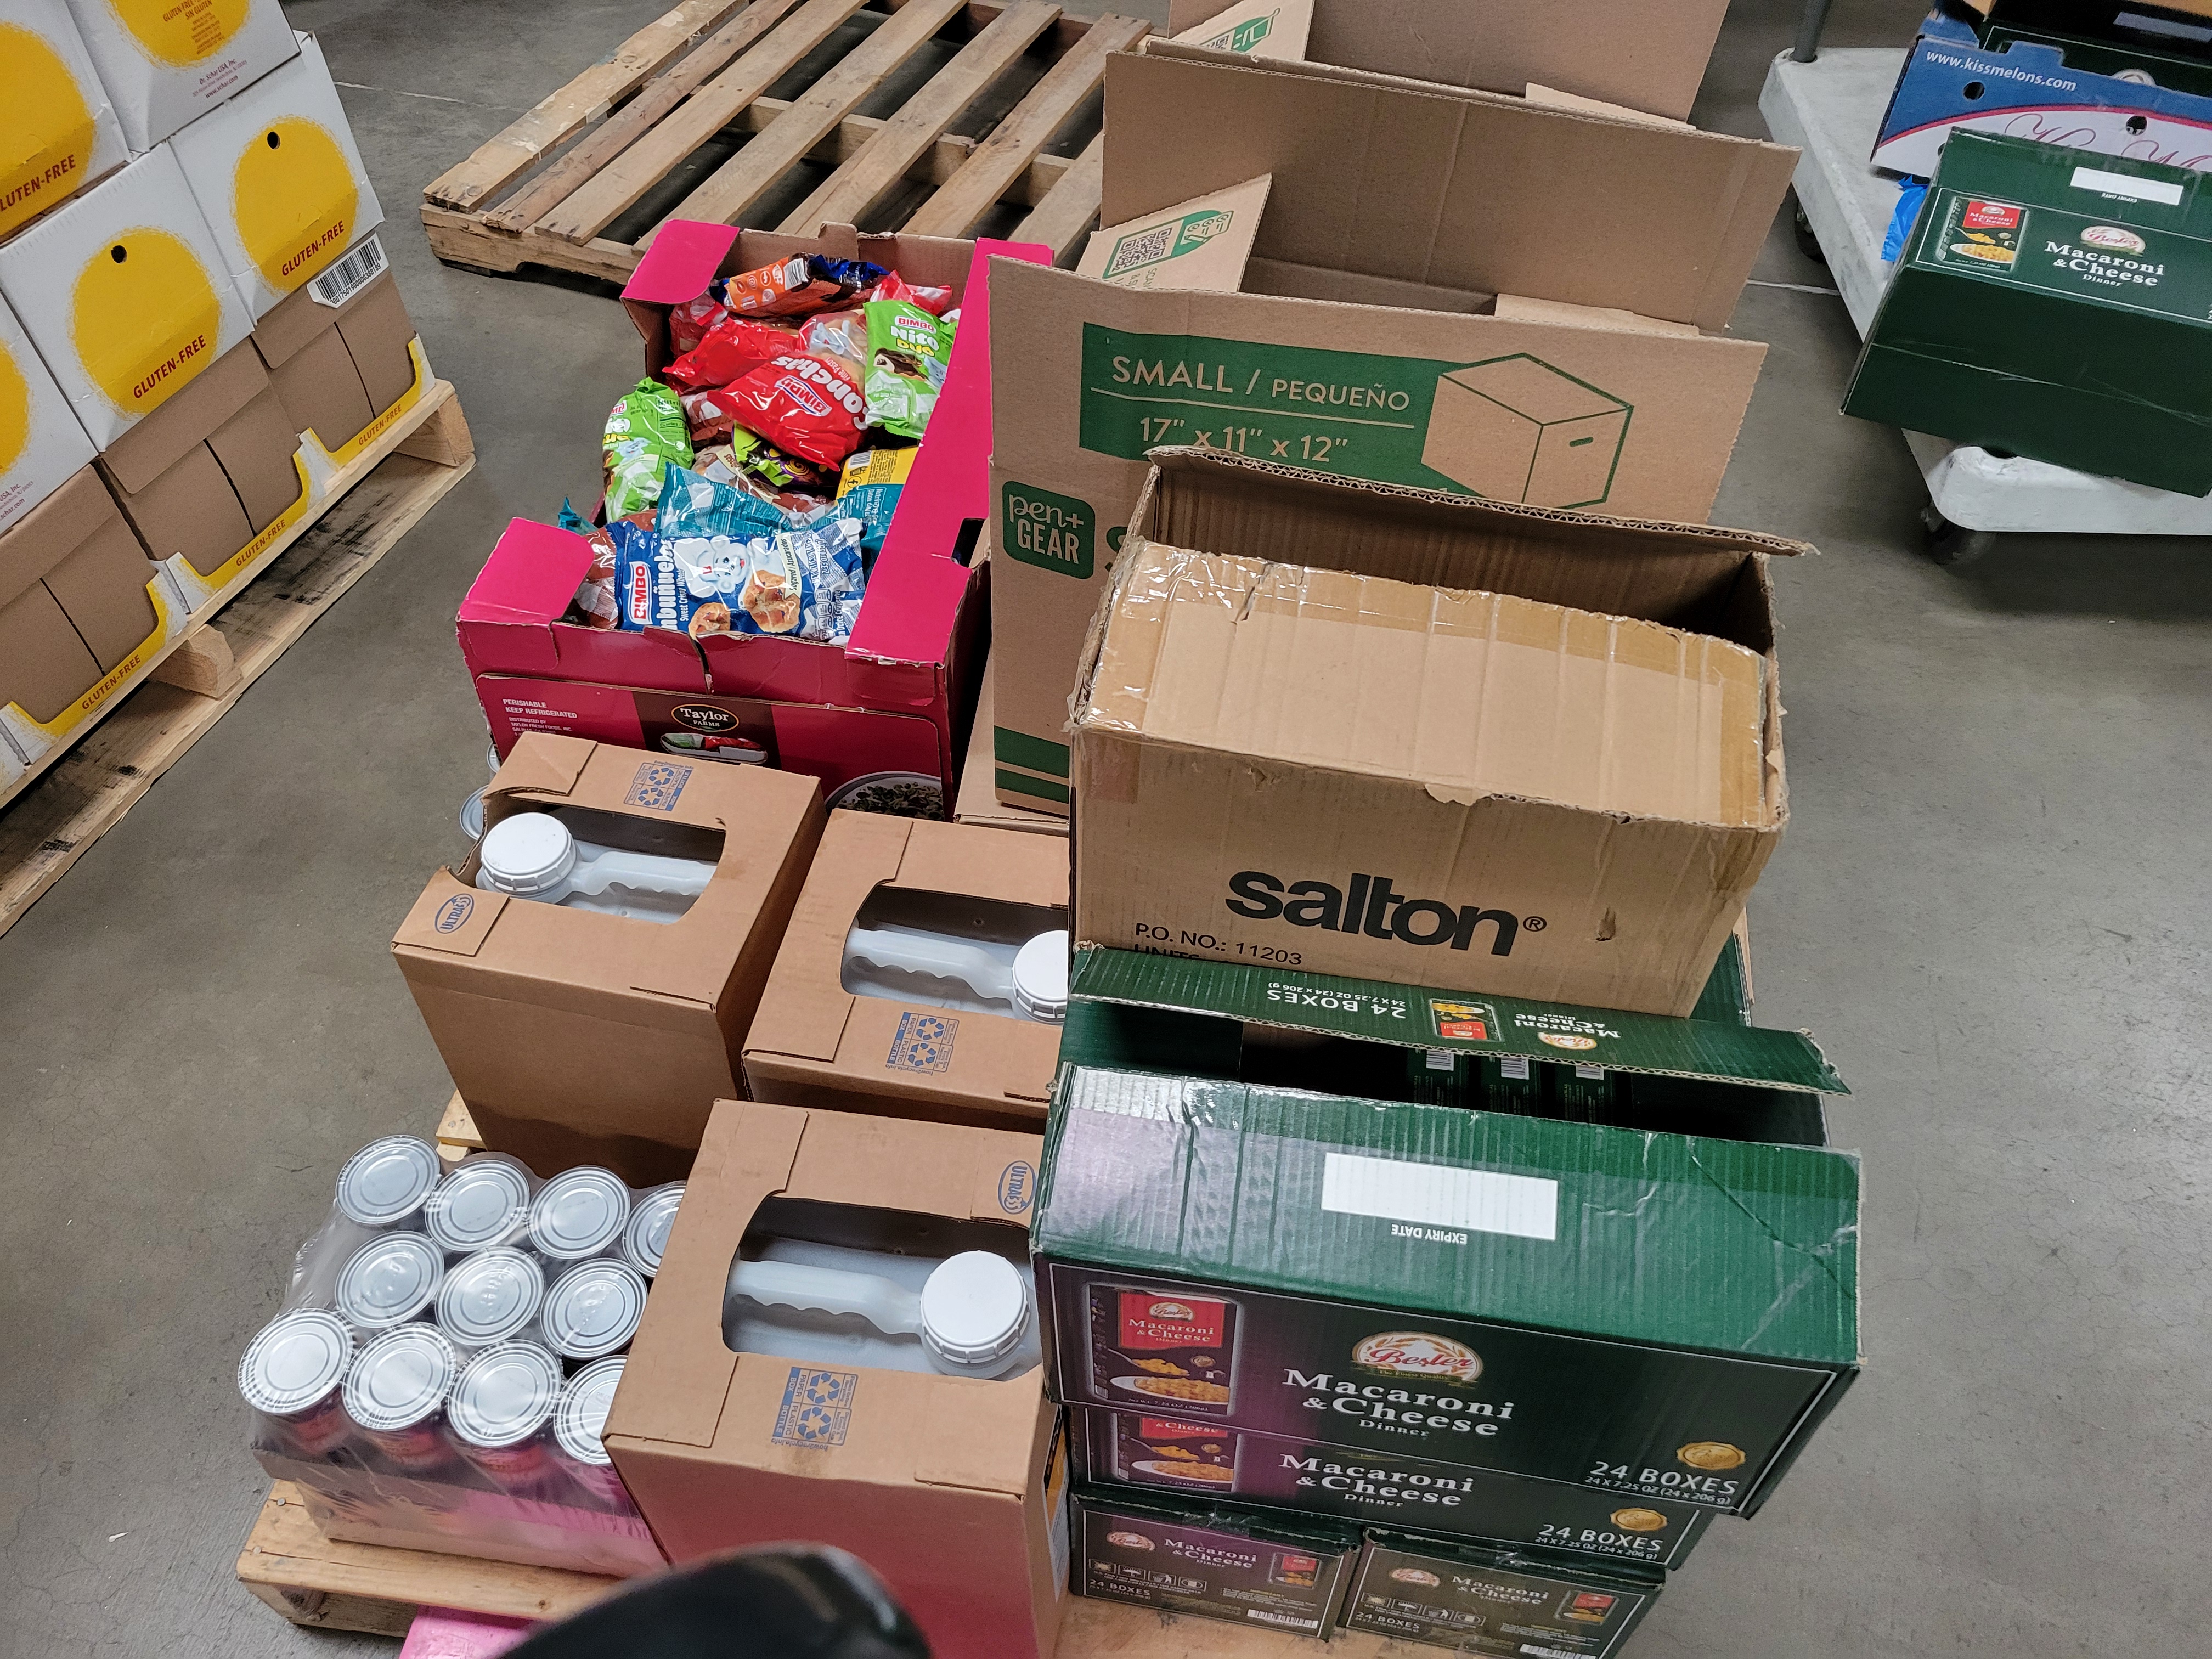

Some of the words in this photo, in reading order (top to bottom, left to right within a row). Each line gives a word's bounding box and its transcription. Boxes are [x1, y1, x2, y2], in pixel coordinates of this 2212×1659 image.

[1926, 49, 2077, 92] www.kissmelons.com
[0, 154, 76, 212] LUTEN-FREE
[281, 220, 345, 276] GLUTEN-FREE
[2044, 240, 2164, 276] Macaroni
[2053, 258, 2158, 287] &Cheese
[2082, 274, 2123, 287] Dinner
[898, 317, 934, 331] BIMBO
[890, 325, 940, 351] Nito
[133, 334, 207, 399] GLUTEN-FREE
[1112, 356, 1233, 394] SMALL
[1272, 377, 1410, 411] PEQUEÑO
[358, 404, 402, 446] GLUTEN-FREE
[1194, 430, 1213, 449] x
[1271, 439, 1289, 459] x
[0, 498, 25, 521] .schar.com
[1009, 494, 1084, 528] pen+
[235, 519, 286, 567] GLUTEN-FREE
[781, 538, 795, 566] Azucarados
[1017, 518, 1079, 565] GEAR
[634, 565, 647, 619] BIMBO
[678, 588, 689, 603] Crispy
[680, 604, 689, 622] Sweet
[834, 615, 845, 630] Dulce
[82, 654, 142, 710] GLUTEN-FREE
[503, 698, 548, 708] PERISHABLE
[525, 708, 578, 719] REFRIGERATED
[680, 708, 729, 721] Taylor
[671, 770, 684, 788] PLASTIC
[678, 771, 690, 788] BOTTLE
[669, 795, 678, 805] BOX
[1225, 871, 1519, 958] salton
[1135, 922, 1174, 943] P.O.
[1181, 930, 1227, 952] NO.:
[1235, 942, 1302, 966] 11203
[1283, 985, 1304, 993] 206
[1354, 994, 1379, 1003] 7.25
[1267, 990, 1358, 1012] BOXES
[1370, 1004, 1406, 1019] 24
[1391, 999, 1406, 1007] 24
[899, 1019, 907, 1031] BOX
[906, 1018, 916, 1035] PAPER
[1513, 1019, 1621, 1039] Macaroni
[1514, 1013, 1605, 1030] &Cheese
[889, 1040, 901, 1061] BOTTLE
[897, 1040, 909, 1063] PLASTIC
[1391, 1224, 1423, 1238] DATE
[1424, 1228, 1468, 1245] EXPIRY
[1129, 1319, 1214, 1335] Macaroni
[1137, 1329, 1211, 1342] &Cheese
[787, 1377, 797, 1392] BOX
[795, 1374, 807, 1397] PAPER
[1282, 1368, 1515, 1420] Macaroni
[776, 1404, 789, 1434] BOTTLE
[785, 1405, 798, 1436] PLASTIC
[1302, 1397, 1499, 1436] &Cheese
[1359, 1419, 1430, 1438] Dinner
[1279, 1454, 1475, 1493] Macaroni
[1589, 1461, 1628, 1479] 24
[1639, 1468, 1739, 1495] BOXES
[1295, 1476, 1462, 1506] &Cheese
[1344, 1493, 1404, 1508] Dinner
[1584, 1476, 1601, 1484] 24
[1612, 1480, 1639, 1491] 7.25
[1660, 1487, 1680, 1497] (24
[1690, 1491, 1716, 1502] 206
[1716, 1496, 1731, 1505] g)
[1538, 1523, 1571, 1538] 24
[1579, 1529, 1663, 1552] BOXES
[1164, 1538, 1257, 1562] Macaroni
[1172, 1549, 1254, 1568] &Cheese
[1558, 1538, 1581, 1548] 7.25
[1598, 1544, 1616, 1553] (24
[1624, 1549, 1644, 1558] 206
[1646, 1552, 1658, 1560] g)
[1089, 1579, 1104, 1588] 24
[1110, 1582, 1151, 1596] BOXES
[1452, 1576, 1549, 1600] Macaroni
[1458, 1585, 1543, 1605] &Cheese
[1356, 1611, 1373, 1620] 24
[1377, 1615, 1421, 1629] BOXES
